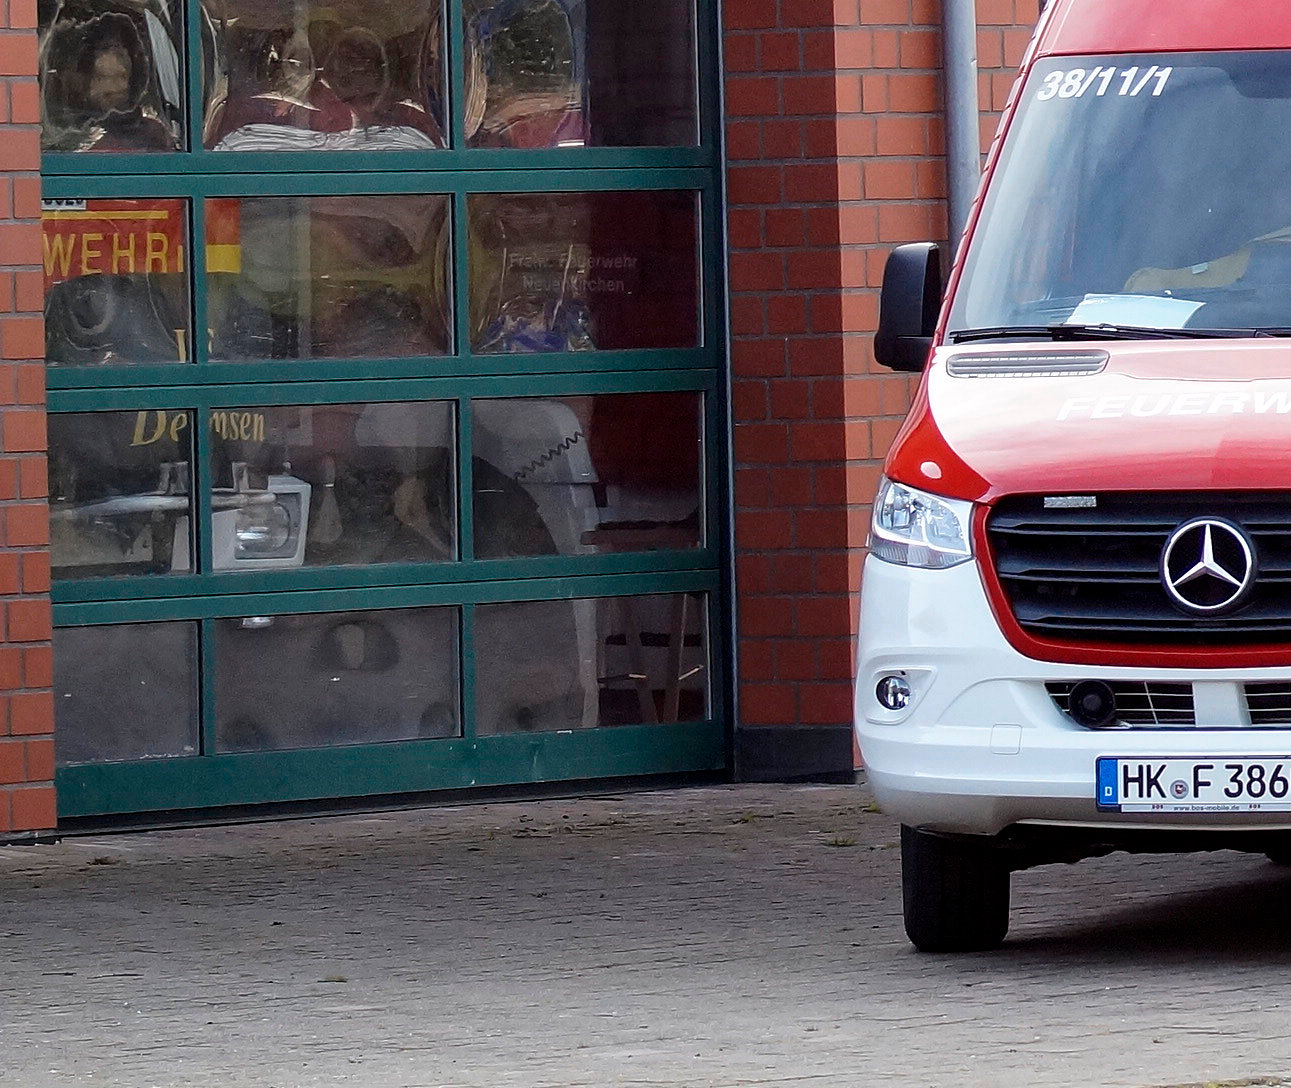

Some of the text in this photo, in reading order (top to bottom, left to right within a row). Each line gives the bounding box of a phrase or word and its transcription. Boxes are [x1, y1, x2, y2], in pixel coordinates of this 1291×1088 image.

[1037, 65, 1173, 101] 38/11/1
[129, 411, 266, 447] Demsen
[1122, 764, 1167, 799] HK
[1193, 764, 1214, 799] F
